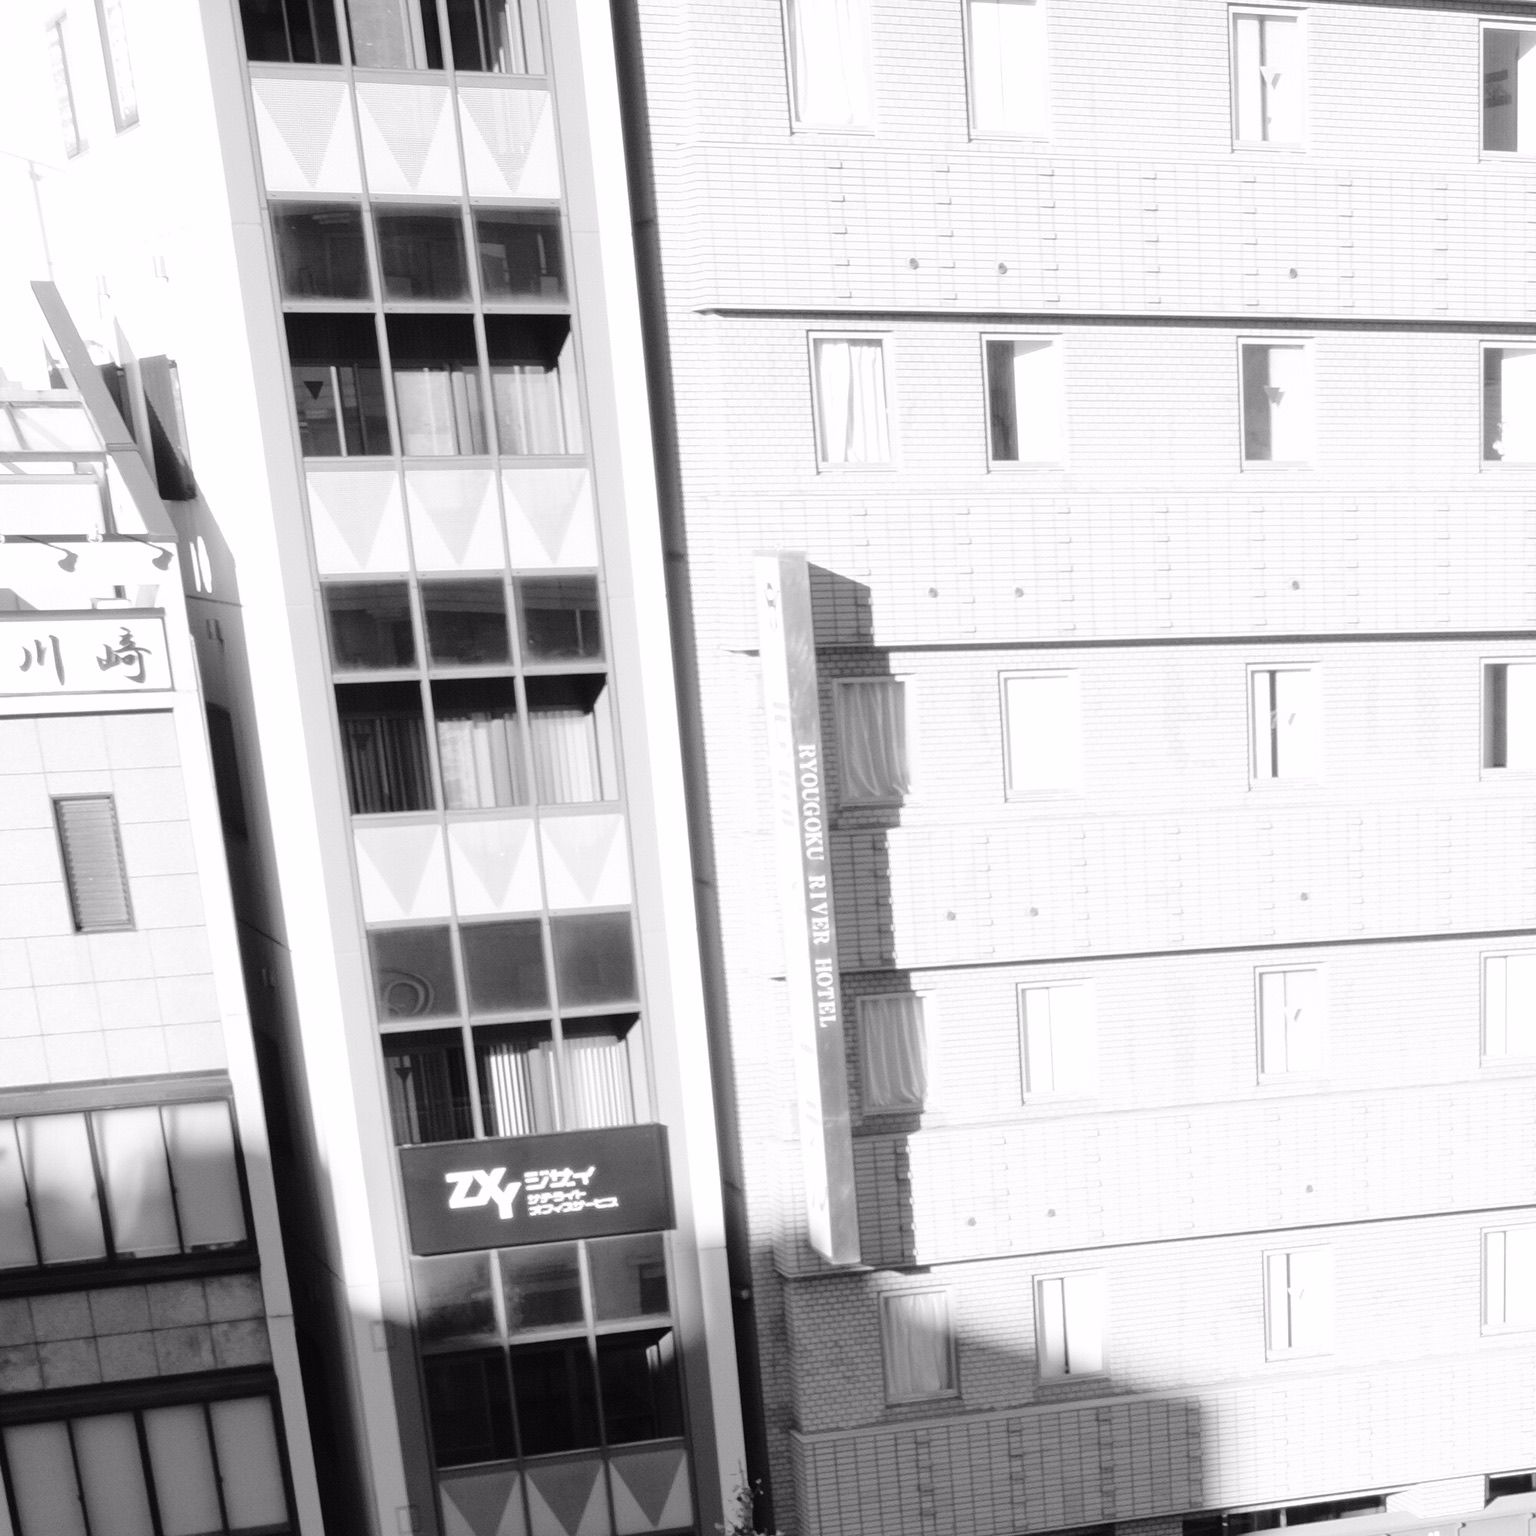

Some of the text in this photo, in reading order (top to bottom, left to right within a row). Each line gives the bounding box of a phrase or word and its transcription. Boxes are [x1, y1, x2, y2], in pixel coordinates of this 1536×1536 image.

[18, 626, 152, 686] 川崎
[798, 743, 826, 861] RYOUGOKU
[807, 874, 831, 946] RIVER
[814, 957, 837, 1029] HOTEL
[445, 1166, 522, 1220] ZXY
